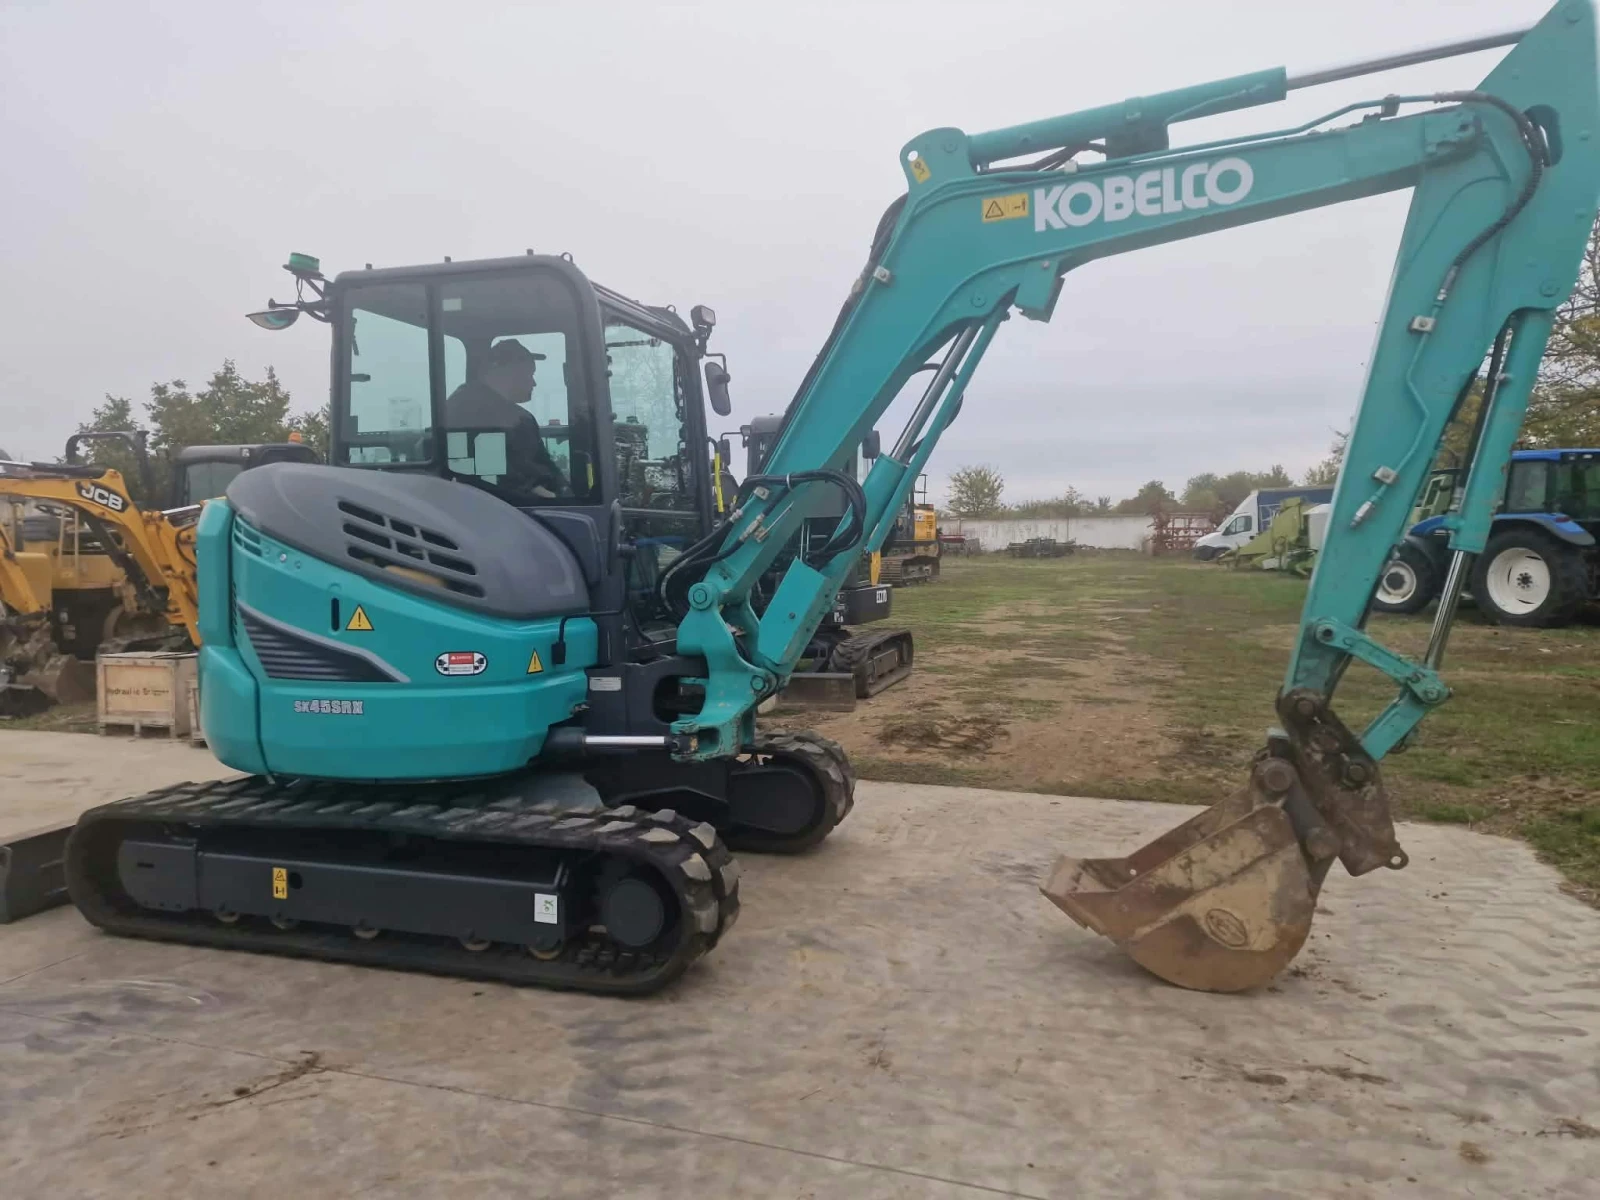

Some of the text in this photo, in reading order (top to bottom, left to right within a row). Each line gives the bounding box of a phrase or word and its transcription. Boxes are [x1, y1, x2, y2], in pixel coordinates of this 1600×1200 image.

[1034, 157, 1254, 232] KOBELCO
[81, 485, 123, 510] JCB
[294, 699, 364, 715] SK45SRX
